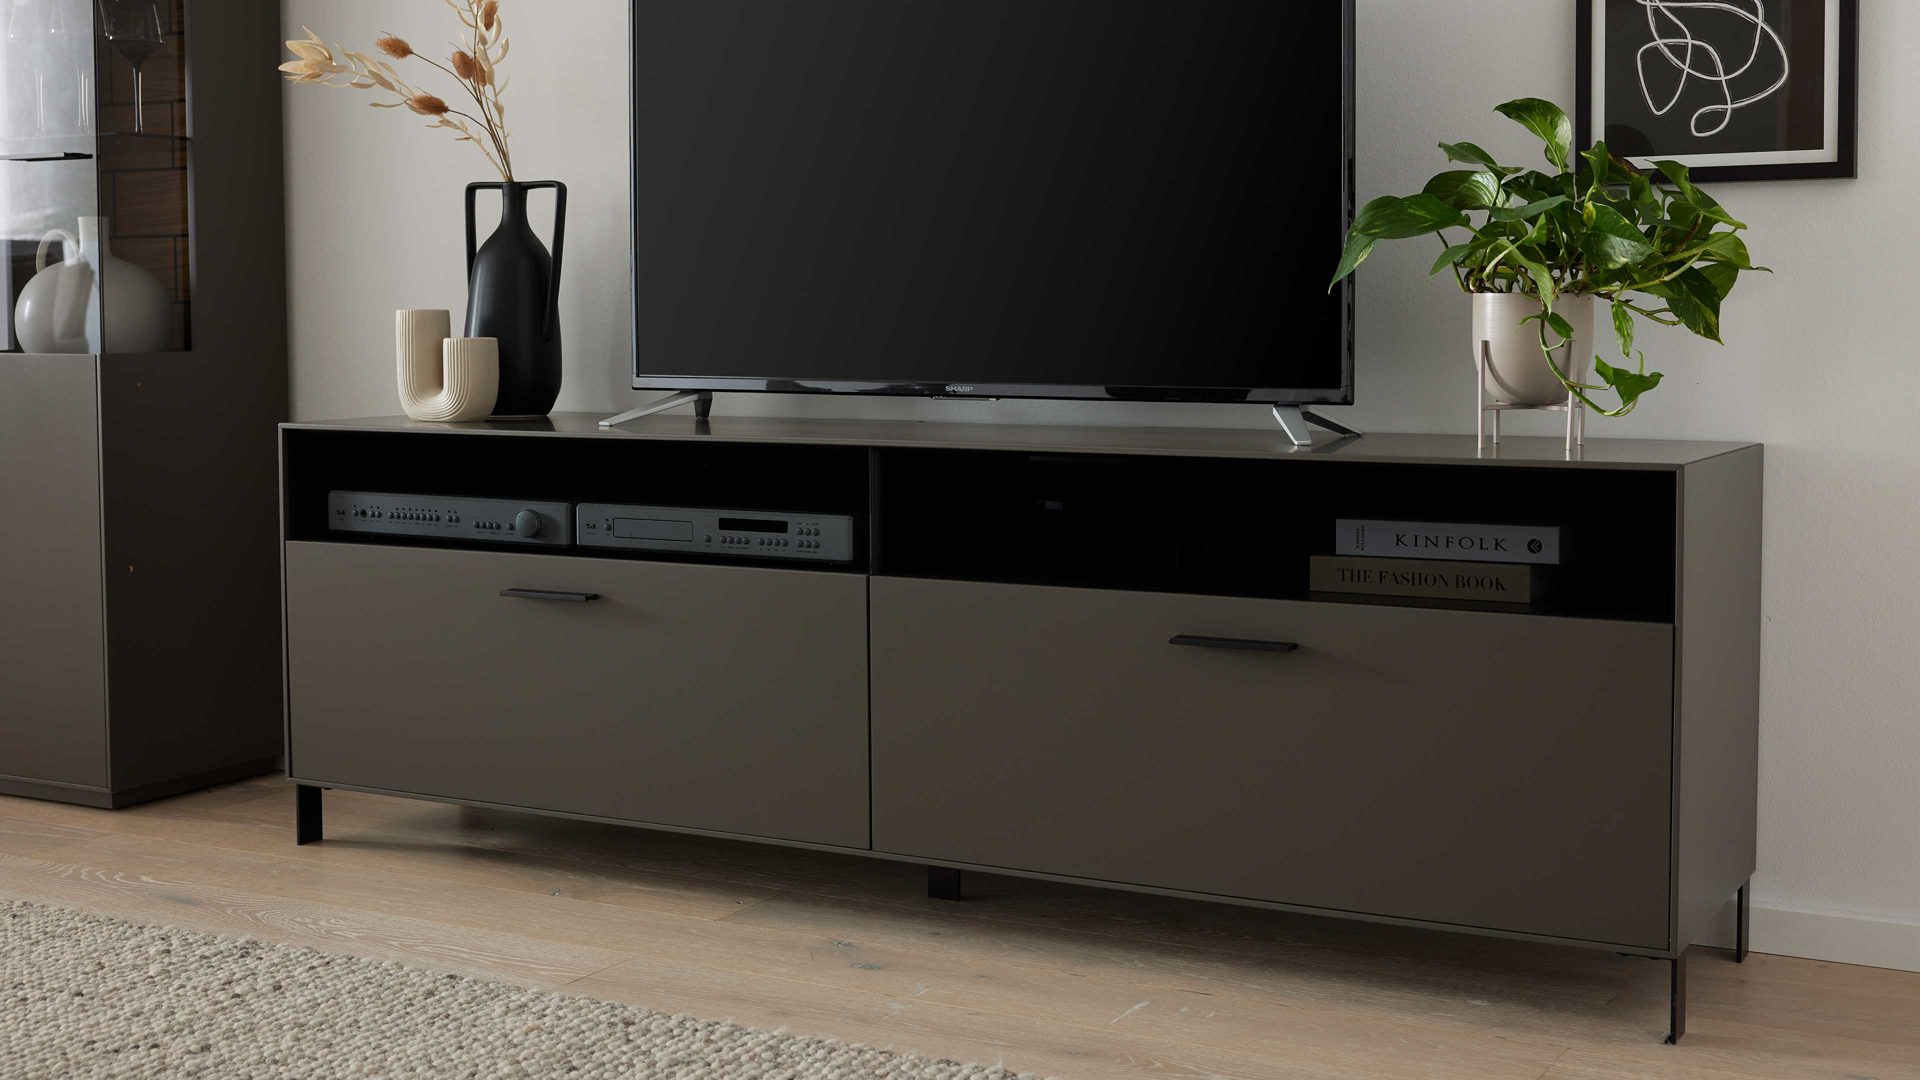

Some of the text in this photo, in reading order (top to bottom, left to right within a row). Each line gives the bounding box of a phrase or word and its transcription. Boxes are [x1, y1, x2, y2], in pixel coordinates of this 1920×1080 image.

[1395, 533, 1508, 551] KINFOLK
[1337, 568, 1374, 584] THE
[1455, 574, 1507, 592] BOOK
